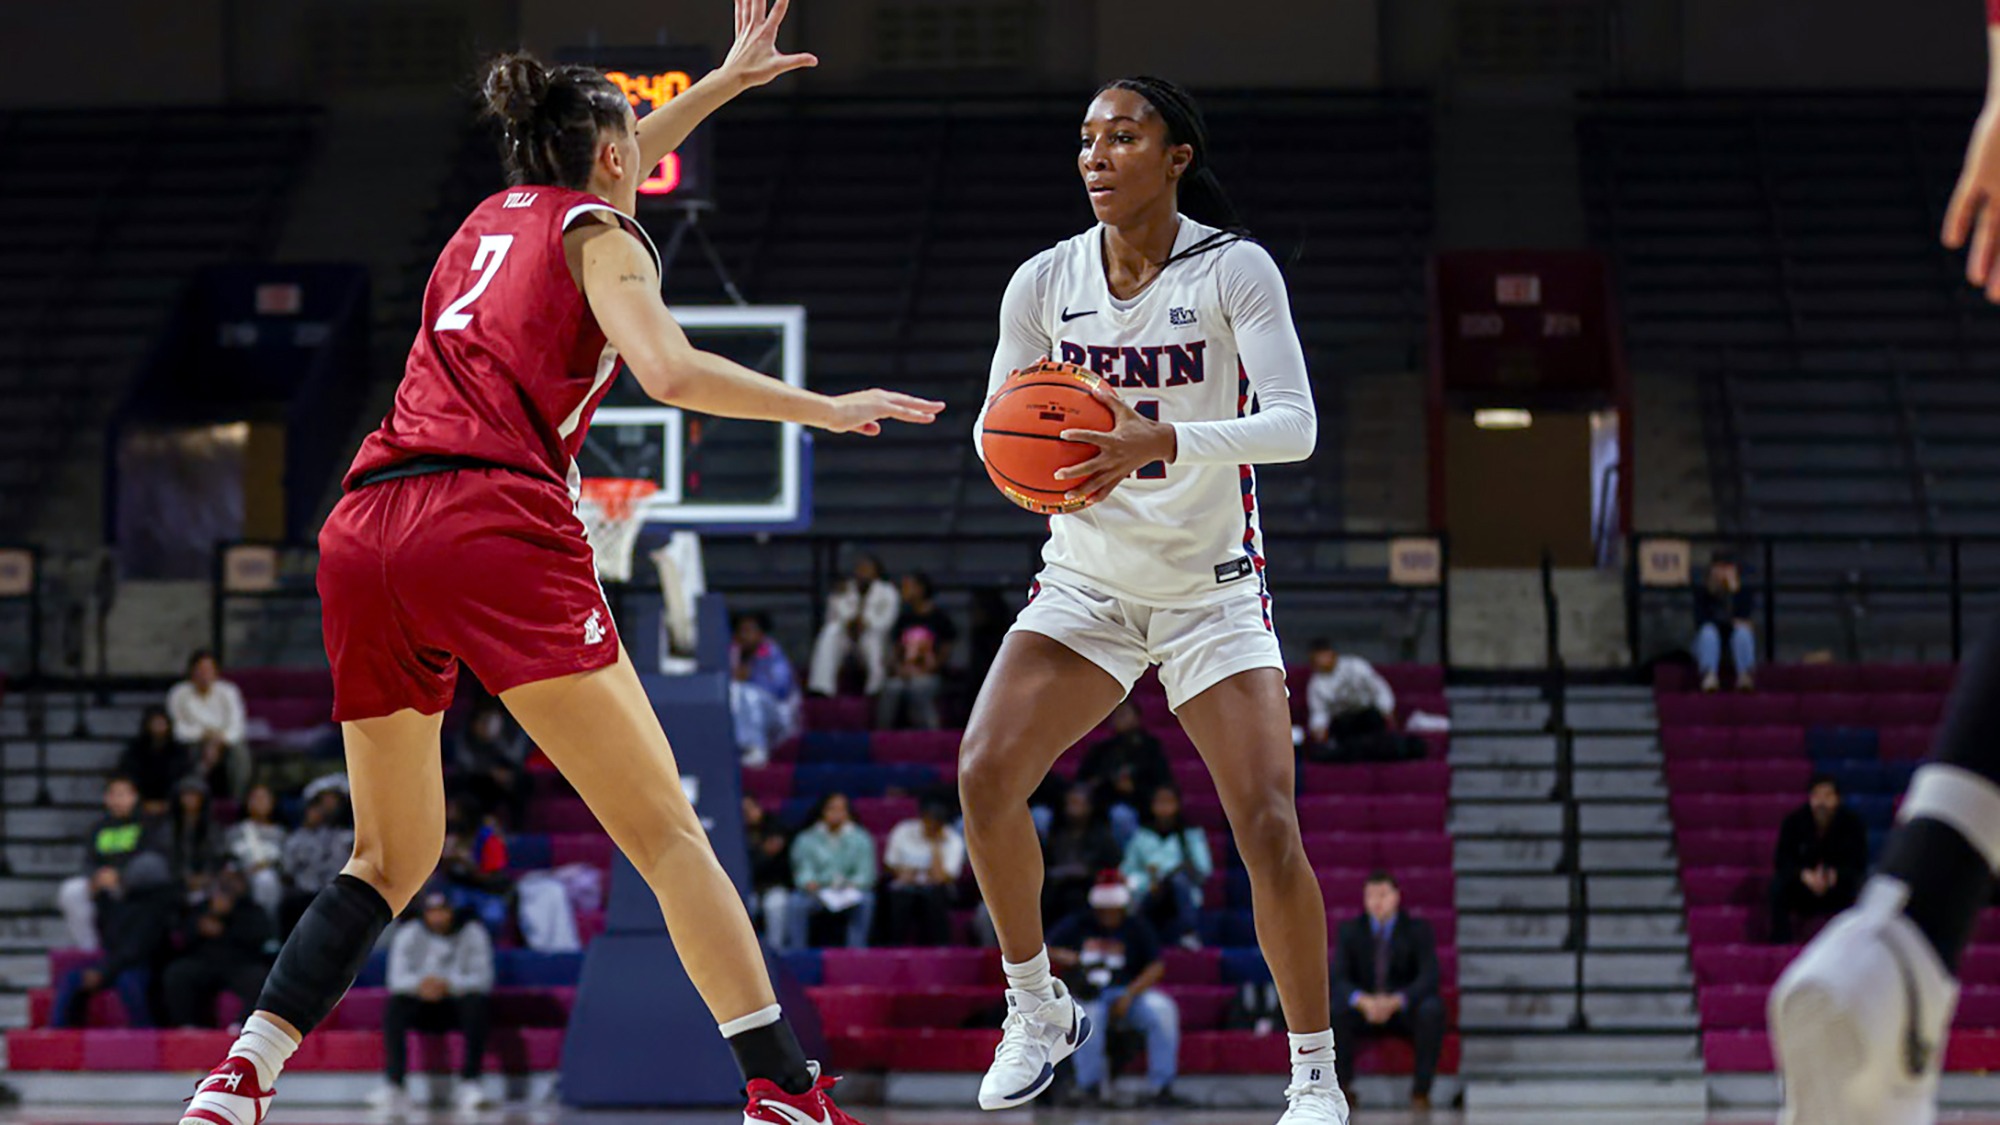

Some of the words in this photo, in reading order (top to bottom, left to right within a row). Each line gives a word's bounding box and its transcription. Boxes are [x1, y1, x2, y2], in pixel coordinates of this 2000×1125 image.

[502, 192, 539, 208] VILLA
[433, 234, 514, 331] 2
[1060, 340, 1207, 388] PENN
